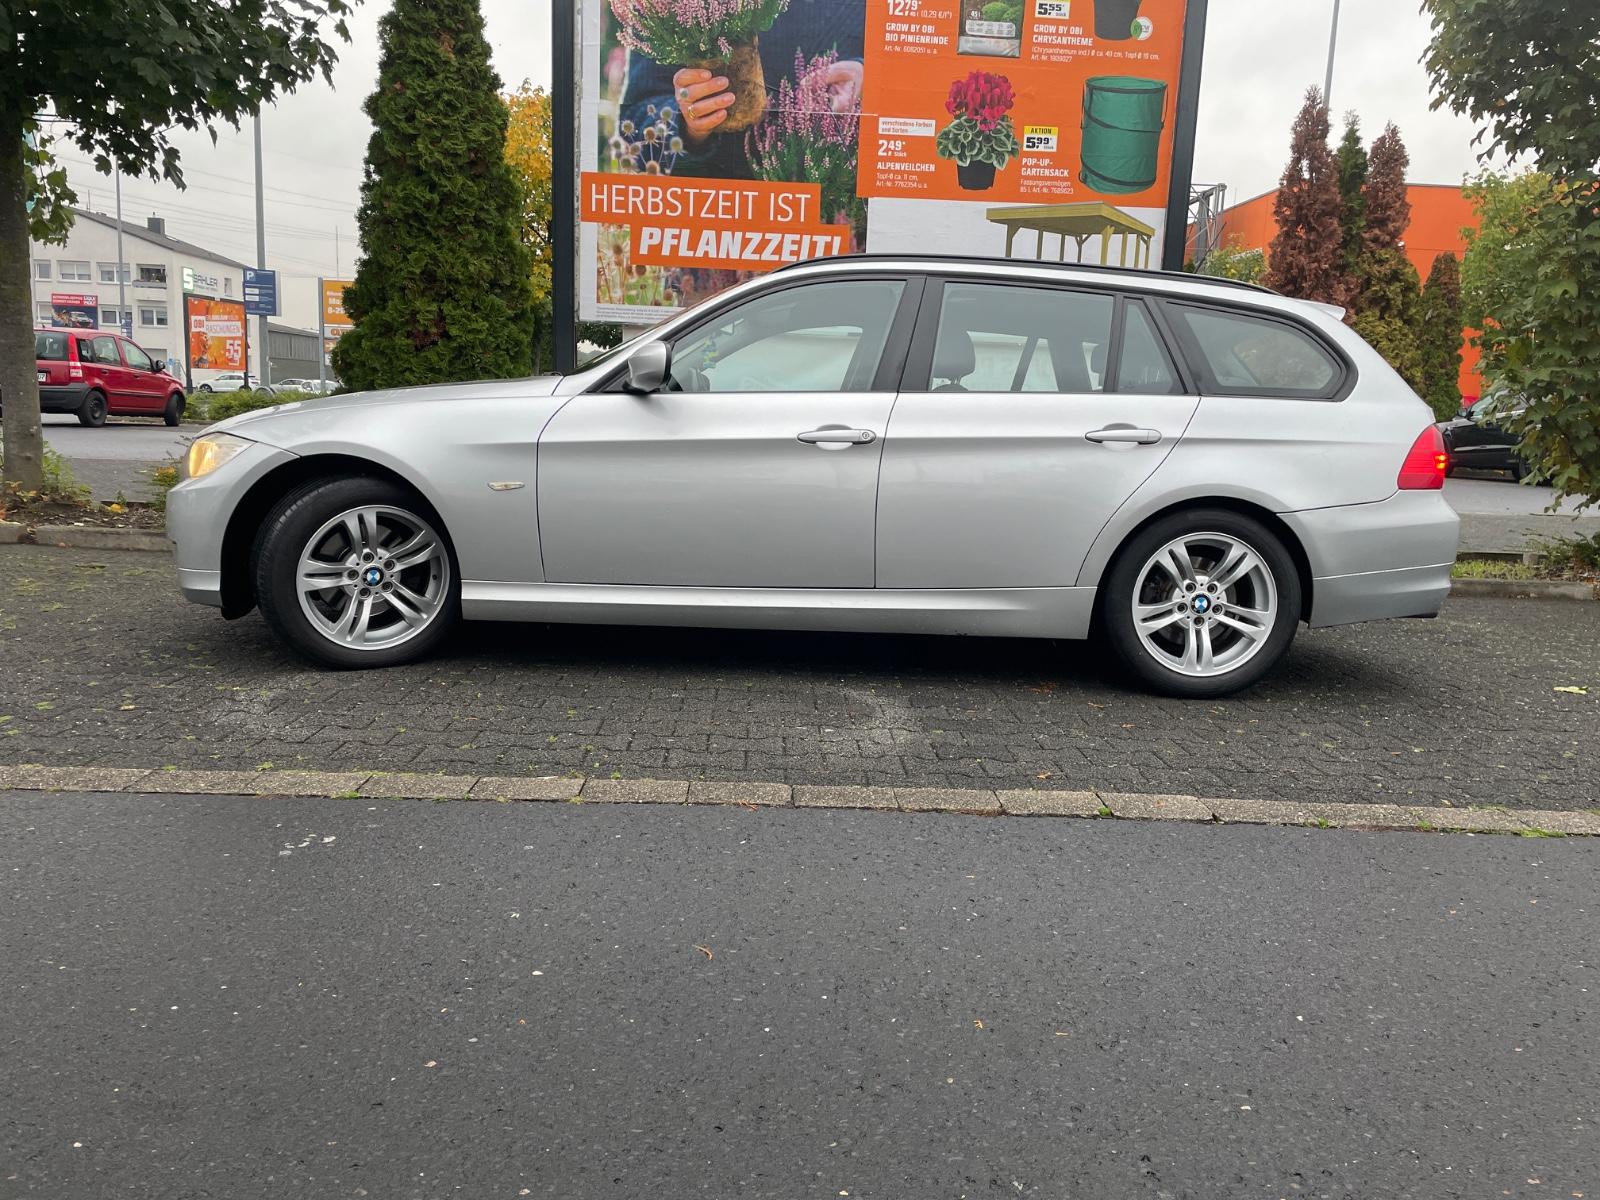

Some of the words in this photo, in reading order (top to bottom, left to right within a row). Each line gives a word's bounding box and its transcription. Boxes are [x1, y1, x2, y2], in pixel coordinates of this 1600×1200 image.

[886, 22, 909, 32] GROW
[911, 24, 920, 32] BY
[922, 25, 935, 33] OBI
[1033, 24, 1056, 33] GROW
[1058, 25, 1068, 33] BY
[1069, 26, 1083, 35] OBI
[885, 33, 898, 42] BIO
[900, 35, 949, 45] PINIENRINDE
[1032, 34, 1094, 46] CHRYSANTHEME
[877, 162, 936, 172] ALPENVEILCHEN
[1022, 158, 1053, 166] POP-UP-
[1021, 168, 1069, 177] GARTENSACK
[591, 183, 758, 220] HERBSTZEIT
[769, 192, 811, 223] IST
[639, 227, 842, 262] PFLANZZEIT!
